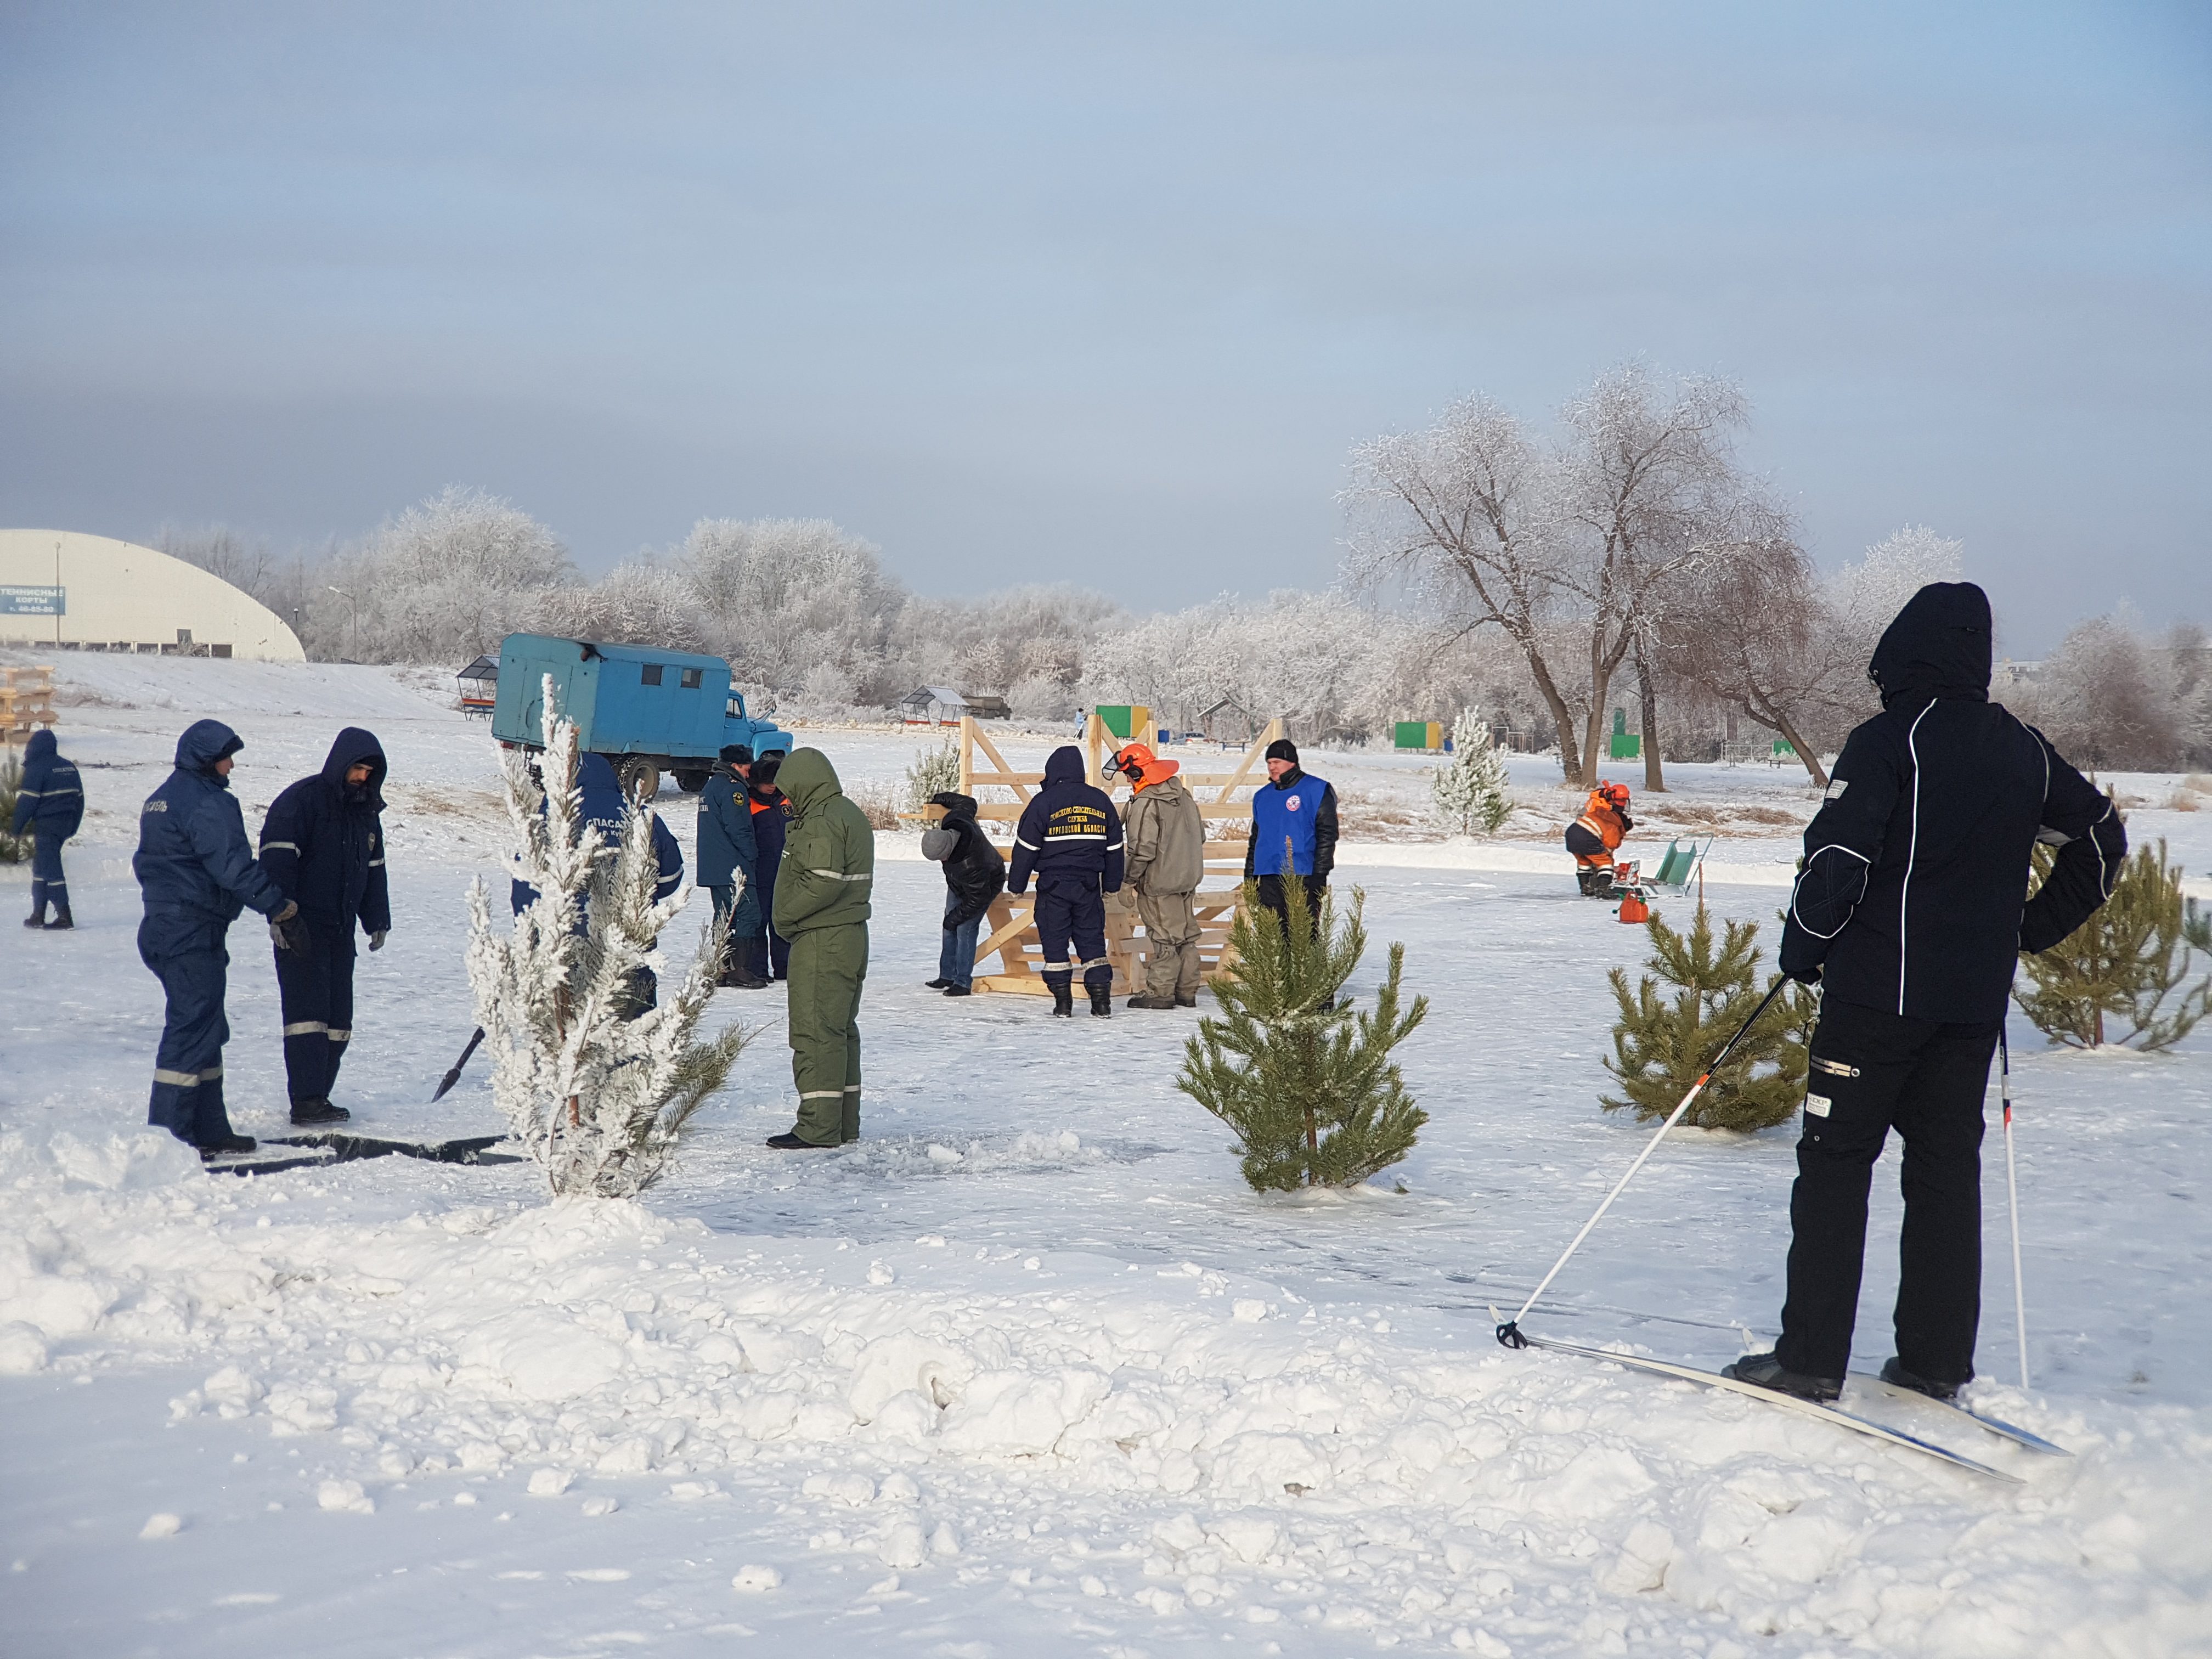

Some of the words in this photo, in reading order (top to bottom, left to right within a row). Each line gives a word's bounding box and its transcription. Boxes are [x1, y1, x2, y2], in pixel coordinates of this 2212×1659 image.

[1, 589, 64, 597] ТЕННИСНЫЕ
[1048, 823, 1081, 835] КУРГАНСКОЙ
[1084, 825, 1105, 833] ОБЛАСТИ
